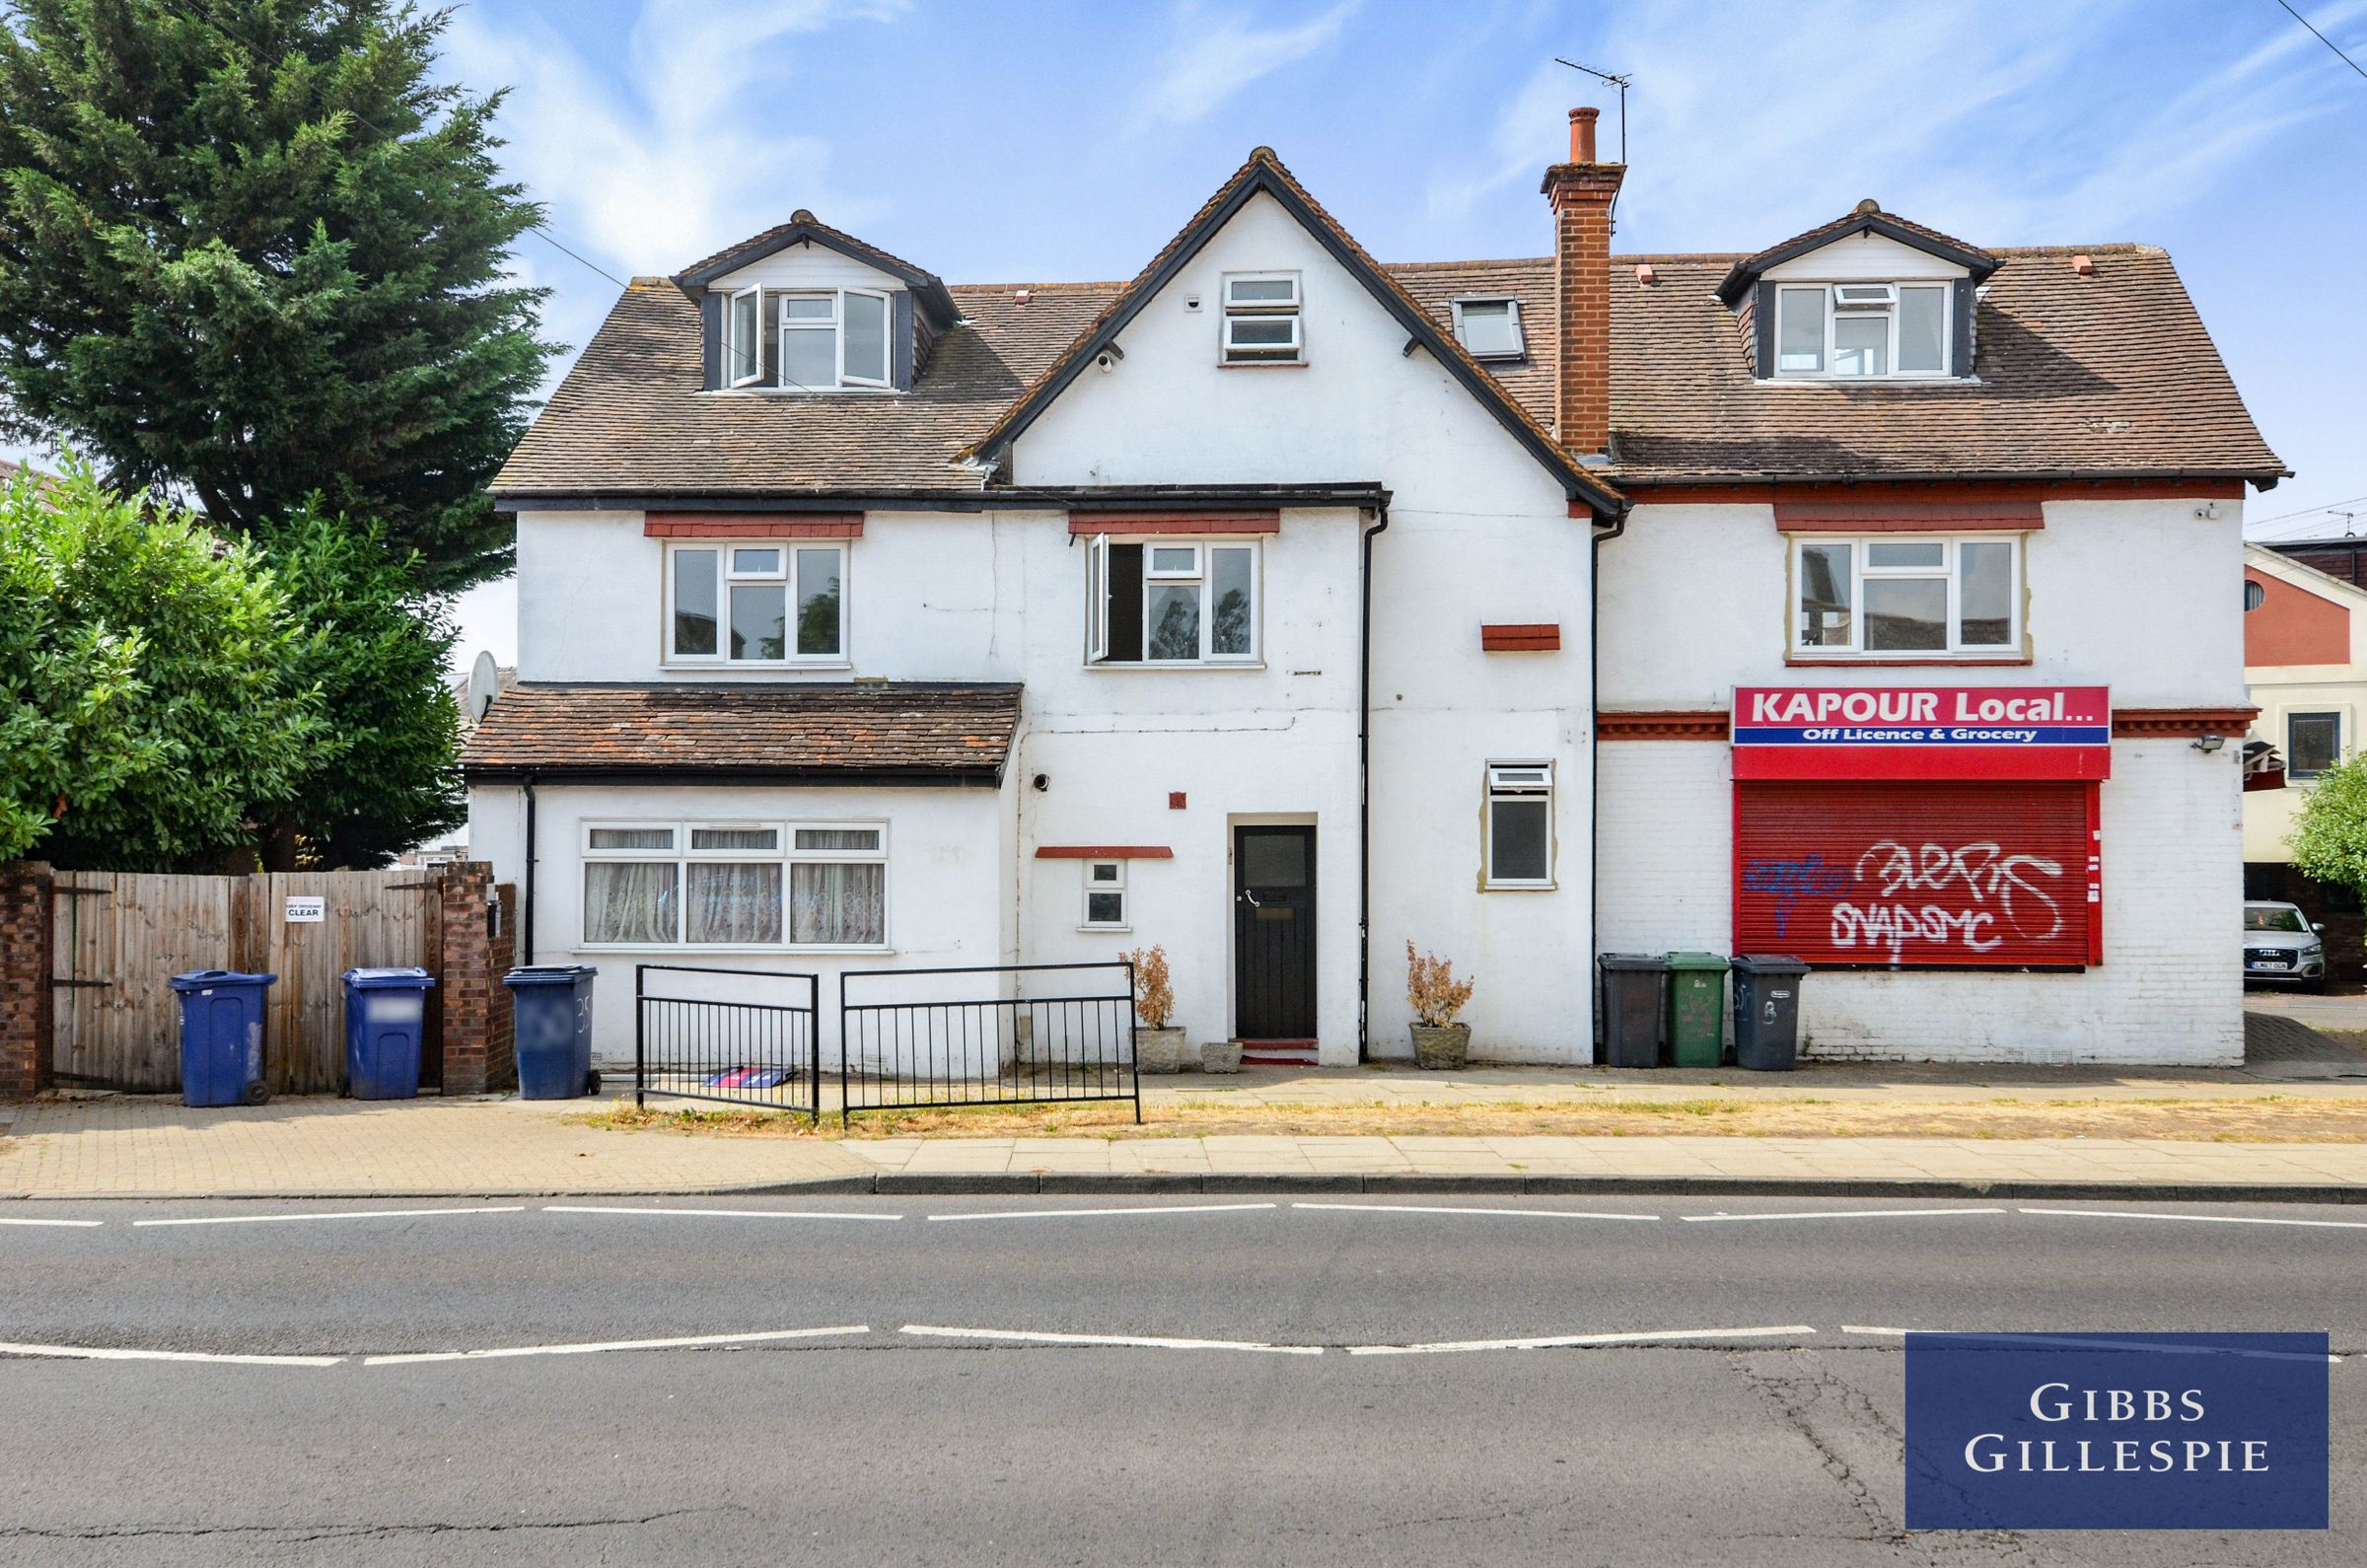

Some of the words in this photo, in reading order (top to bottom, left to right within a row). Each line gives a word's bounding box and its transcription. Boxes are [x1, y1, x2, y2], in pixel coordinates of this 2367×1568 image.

[1752, 692, 1939, 722] KAPOUR
[1955, 692, 2093, 722] Local...
[1803, 729, 1839, 741] Off
[1842, 729, 1925, 741] Licence
[1929, 729, 1946, 740] &
[1951, 728, 2038, 743] Grocery
